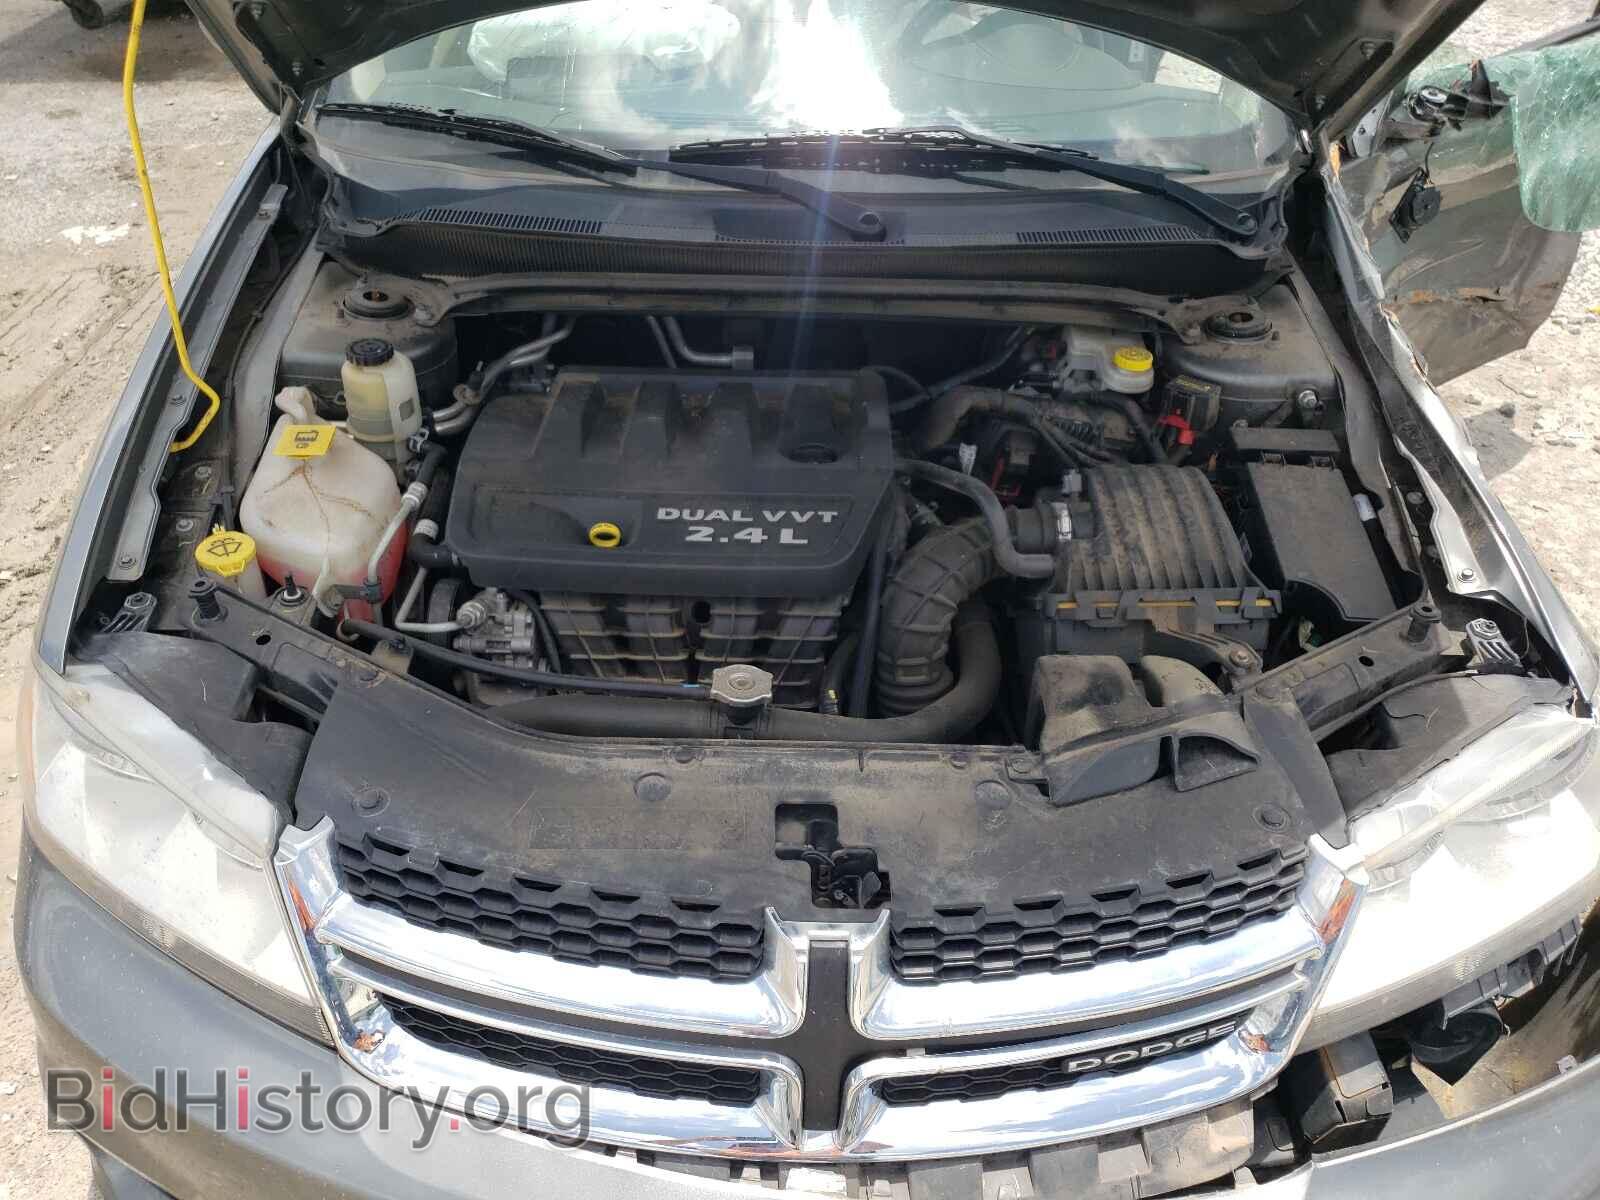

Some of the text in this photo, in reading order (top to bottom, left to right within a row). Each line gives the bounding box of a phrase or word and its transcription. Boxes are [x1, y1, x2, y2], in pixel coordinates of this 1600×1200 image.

[656, 507, 839, 523] DUAL VVT
[1067, 1020, 1237, 1073] DODGE
